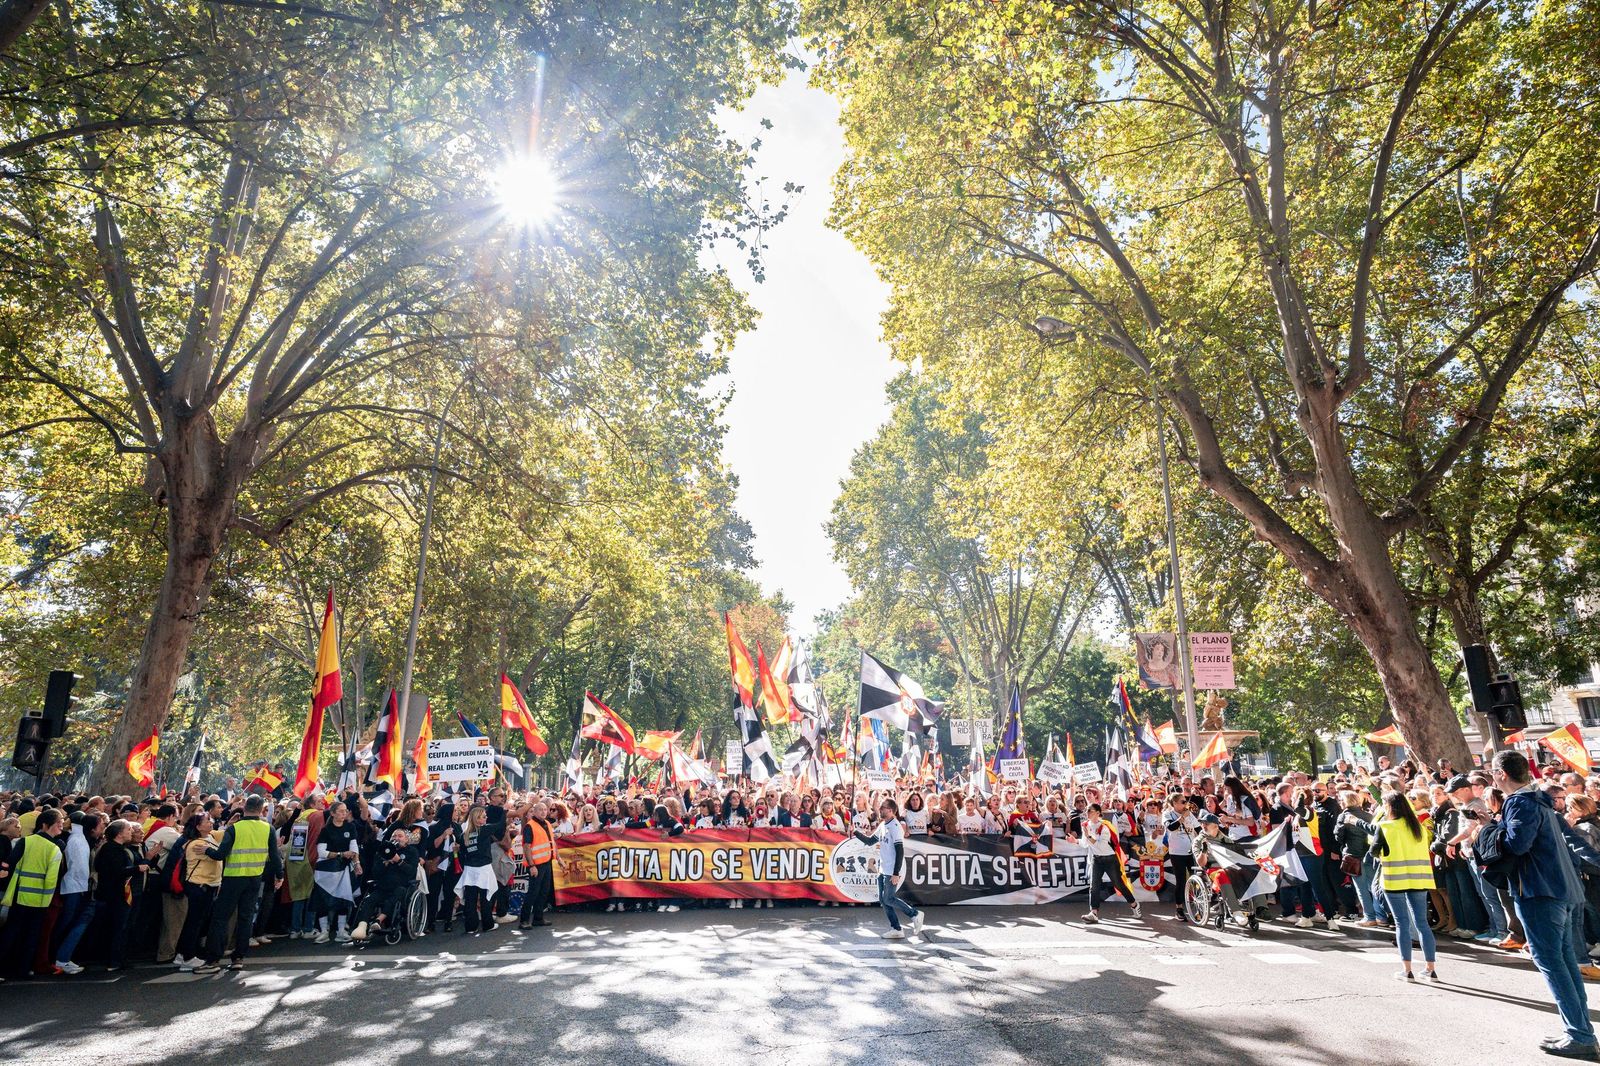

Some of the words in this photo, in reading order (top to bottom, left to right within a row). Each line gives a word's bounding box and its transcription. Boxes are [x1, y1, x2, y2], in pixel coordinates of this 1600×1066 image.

[446, 762, 476, 770] DECRETO
[476, 760, 488, 769] YA
[596, 847, 662, 881] CEUTA
[670, 848, 704, 881] NO
[711, 848, 744, 881] SE
[750, 848, 825, 882] VENDE
[911, 854, 985, 886] CEUTA
[992, 856, 1022, 886] SE
[1024, 856, 1090, 887] DEFIE
[842, 876, 878, 886] CABALL
